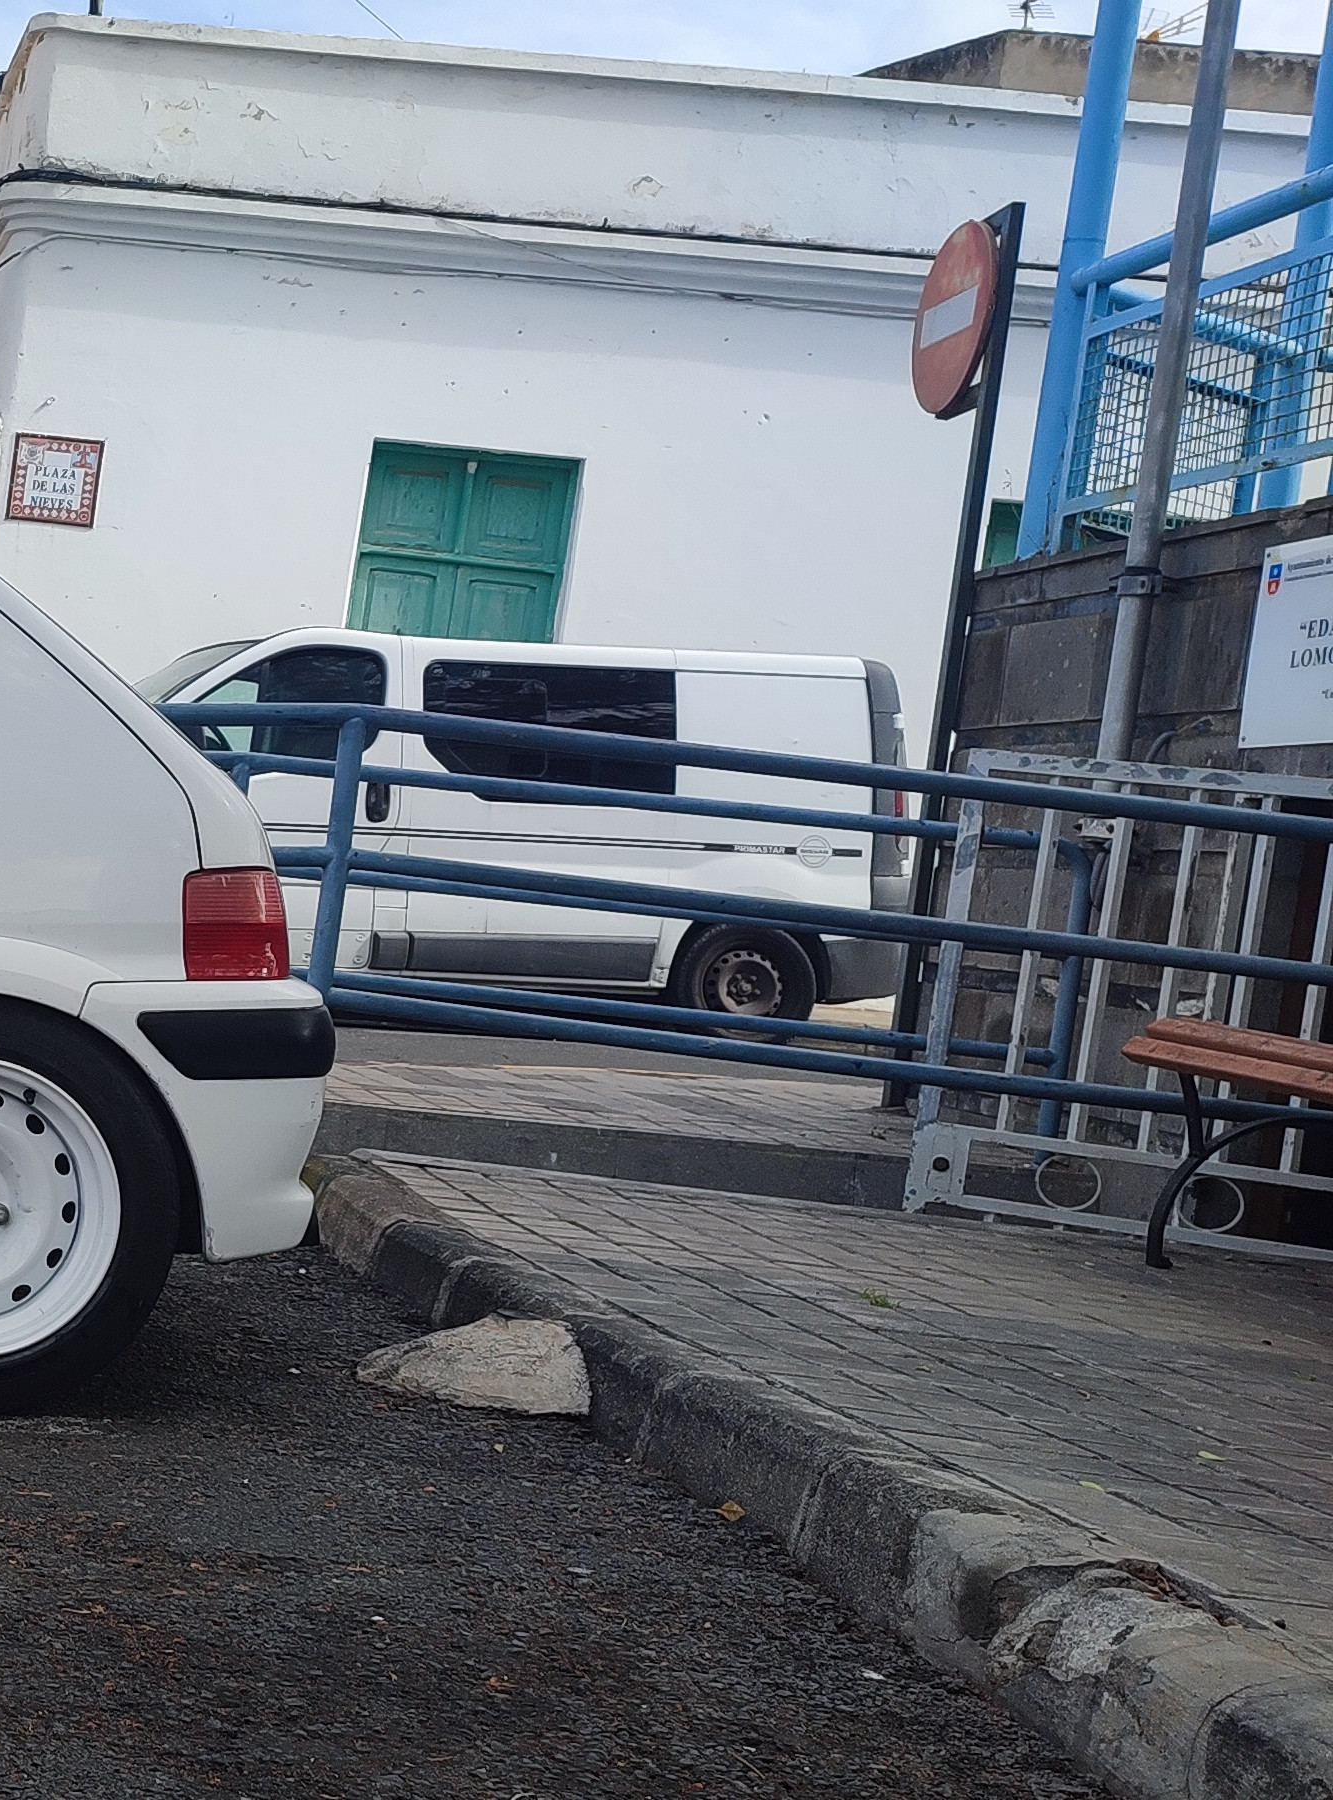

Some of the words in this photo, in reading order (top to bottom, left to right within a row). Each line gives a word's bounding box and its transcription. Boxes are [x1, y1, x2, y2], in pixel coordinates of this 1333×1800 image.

[34, 465, 76, 480] PLAZA
[32, 479, 48, 491] DE
[52, 481, 75, 495] LAS
[30, 495, 74, 510] NIEVES
